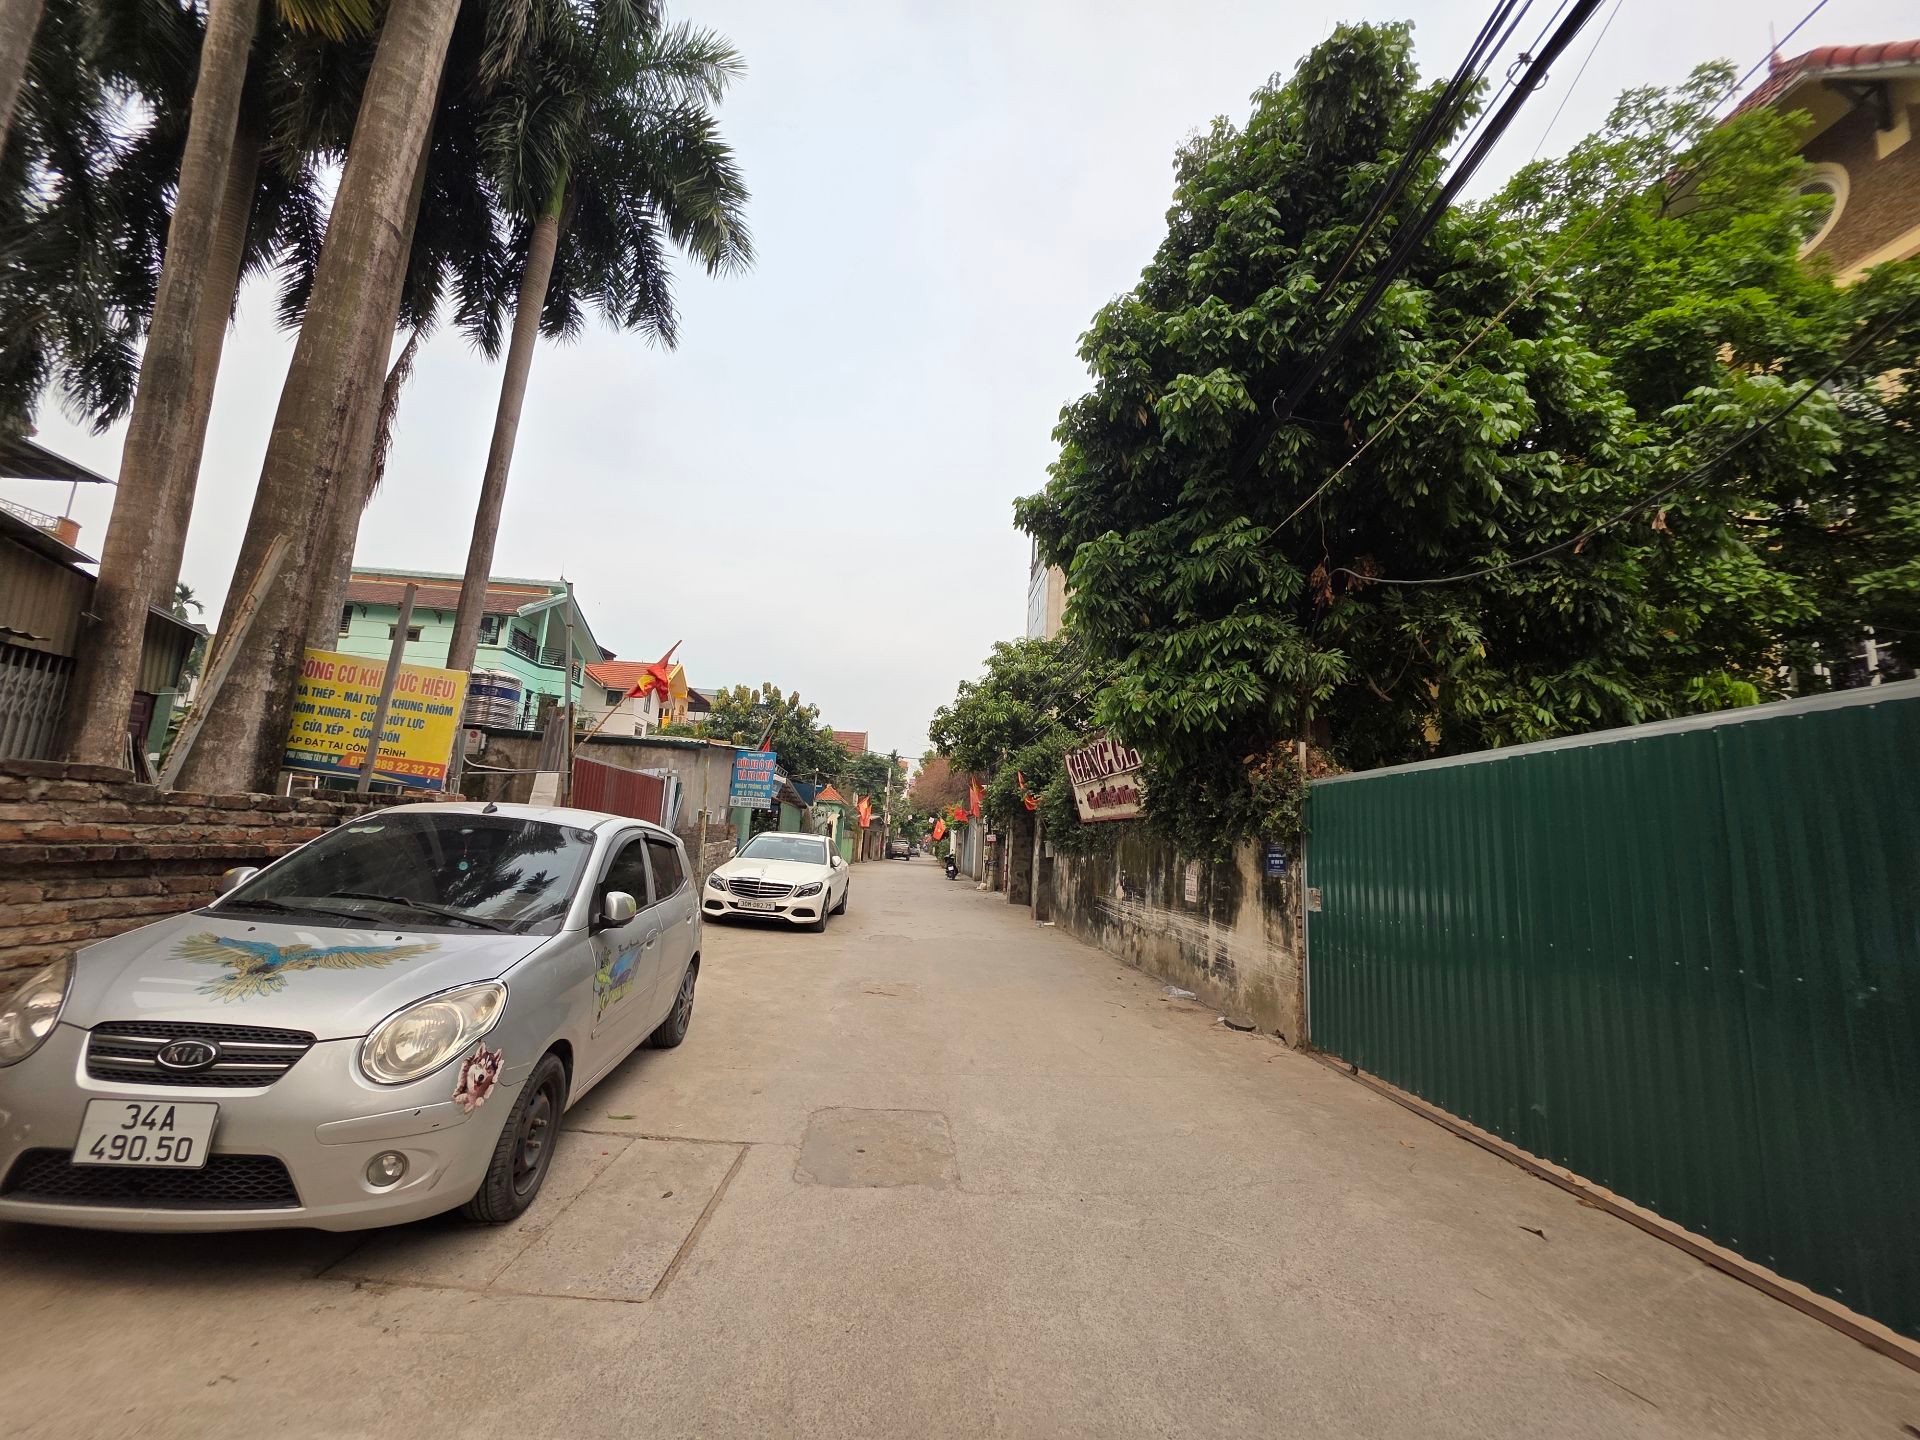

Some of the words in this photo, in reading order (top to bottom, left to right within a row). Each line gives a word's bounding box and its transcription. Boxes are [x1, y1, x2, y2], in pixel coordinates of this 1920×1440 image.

[337, 664, 358, 684] CƠ
[395, 671, 419, 692] ỨC
[421, 675, 456, 700] HIỆU)
[311, 686, 336, 700] THÉP
[344, 690, 363, 704] MÁI
[391, 698, 423, 713] KHUNG
[303, 718, 322, 732] CỬA
[325, 721, 345, 735] XẾP
[378, 729, 401, 744] UỐN
[317, 705, 351, 720] XINGFA
[407, 718, 426, 731] LỰC
[304, 738, 325, 749] ĐẶT
[328, 741, 344, 751] TẠI
[345, 743, 368, 753] CÔN
[378, 747, 406, 758] TRÌNH
[395, 762, 410, 773] 22
[411, 764, 425, 775] 32
[427, 766, 441, 777] 72
[165, 1046, 204, 1063] KIA
[121, 1104, 176, 1131] 34A
[89, 1134, 194, 1163] 490.50
